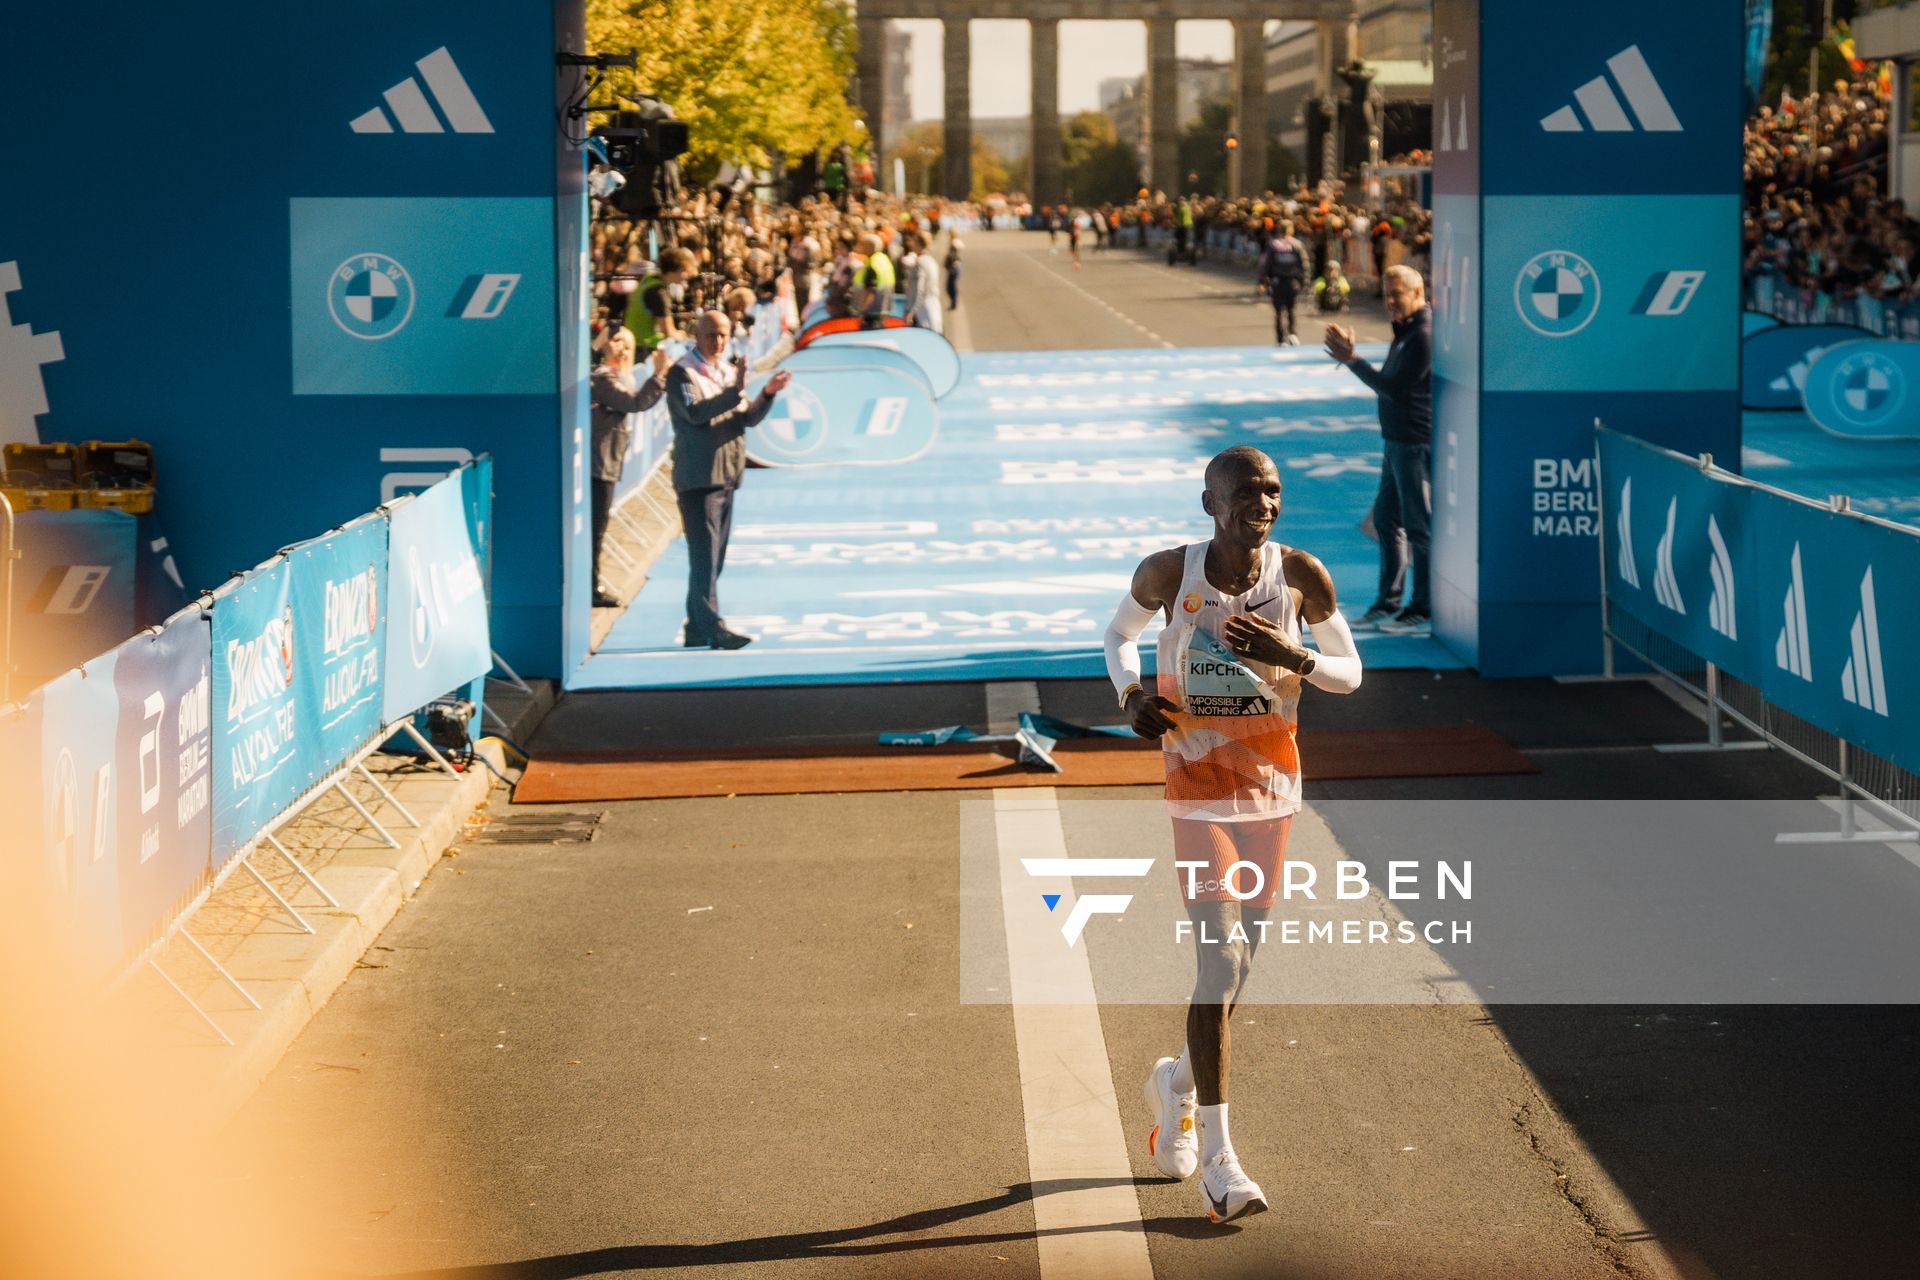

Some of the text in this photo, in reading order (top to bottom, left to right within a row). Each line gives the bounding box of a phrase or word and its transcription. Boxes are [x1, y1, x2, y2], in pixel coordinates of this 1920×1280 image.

[340, 257, 402, 281] BMW
[1197, 706, 1240, 715] NOTHING
[1182, 878, 1227, 897] IEOS
